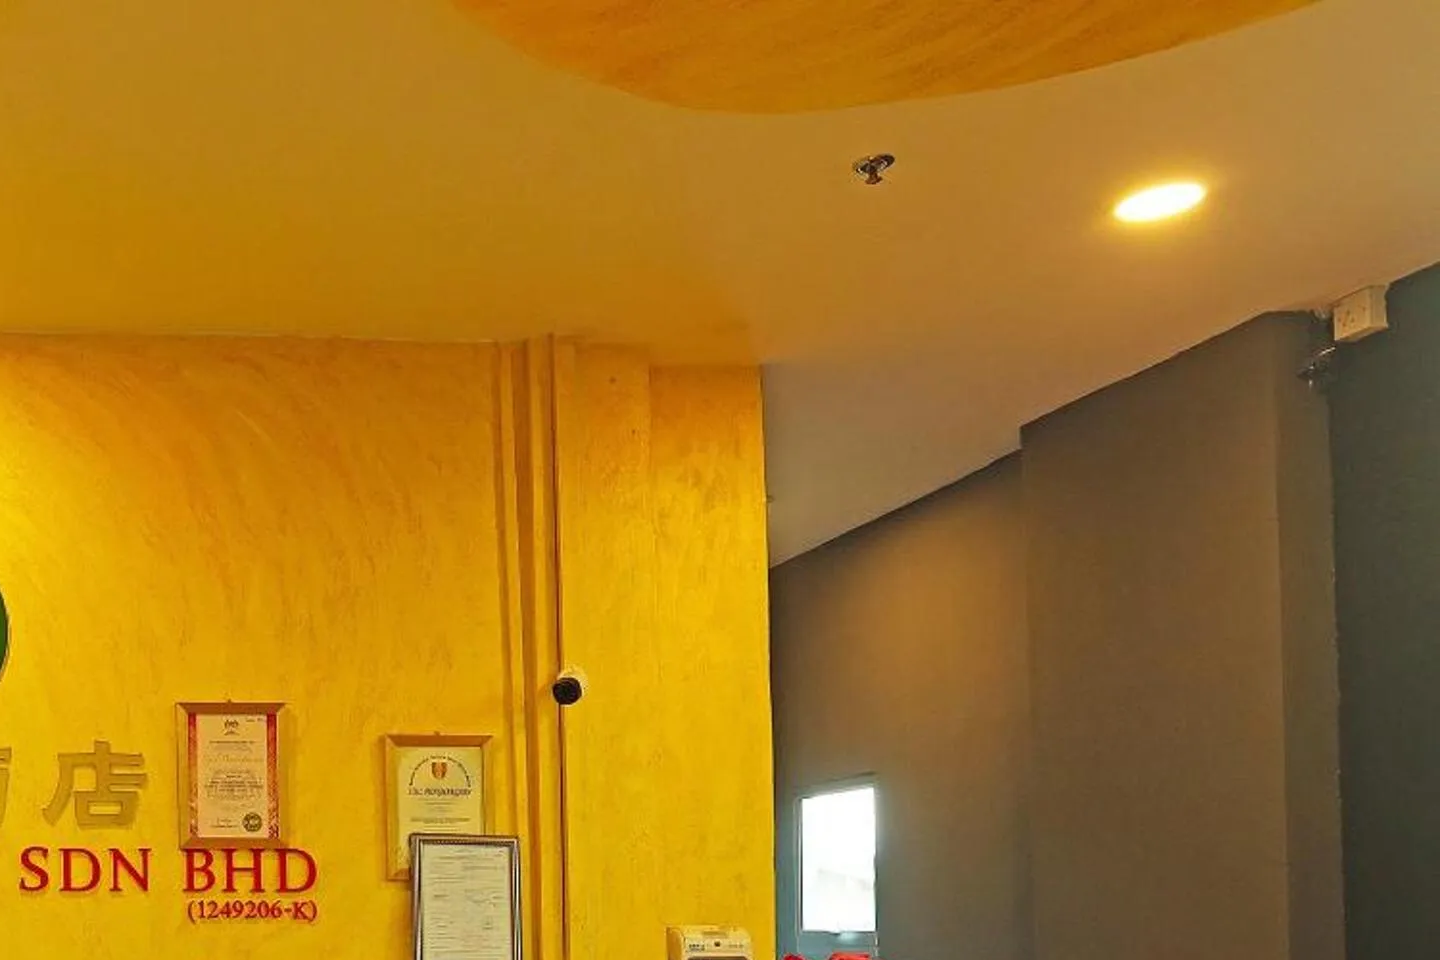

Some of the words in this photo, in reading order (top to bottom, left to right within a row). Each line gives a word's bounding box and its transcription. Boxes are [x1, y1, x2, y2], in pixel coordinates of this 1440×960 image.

[18, 845, 152, 893] SDN
[182, 847, 318, 893] BHD
[186, 899, 318, 922] (1249206-K)
